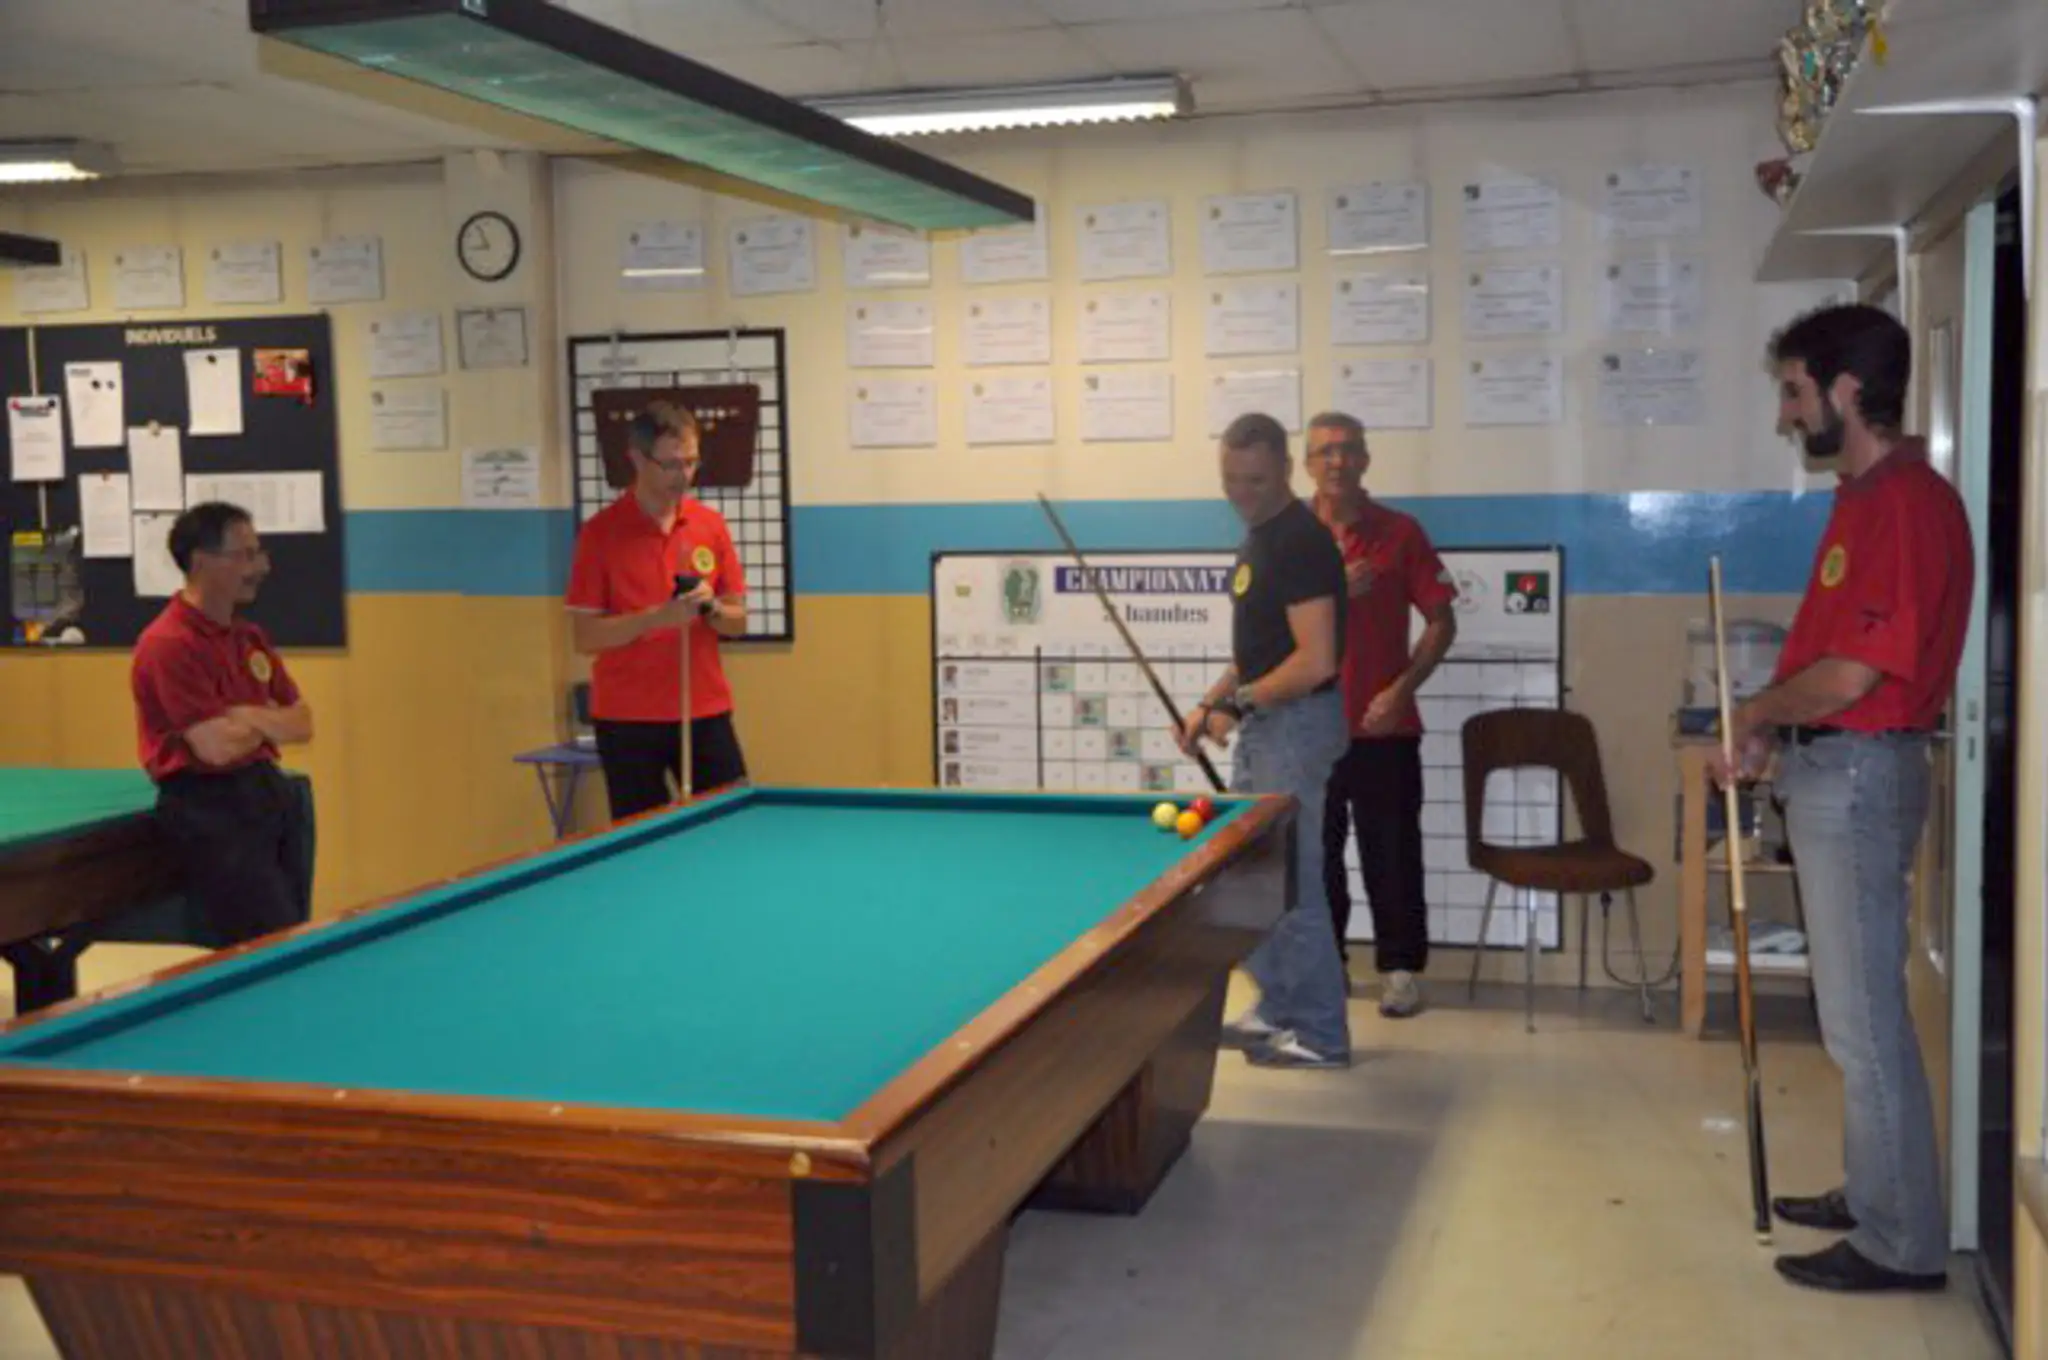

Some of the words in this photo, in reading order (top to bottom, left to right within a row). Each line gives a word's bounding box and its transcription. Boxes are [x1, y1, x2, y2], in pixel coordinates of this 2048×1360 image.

[125, 327, 217, 346] INDIVIDUELS
[1065, 569, 1227, 591] CHAMPIONNAT
[1125, 604, 1208, 623] bandes
